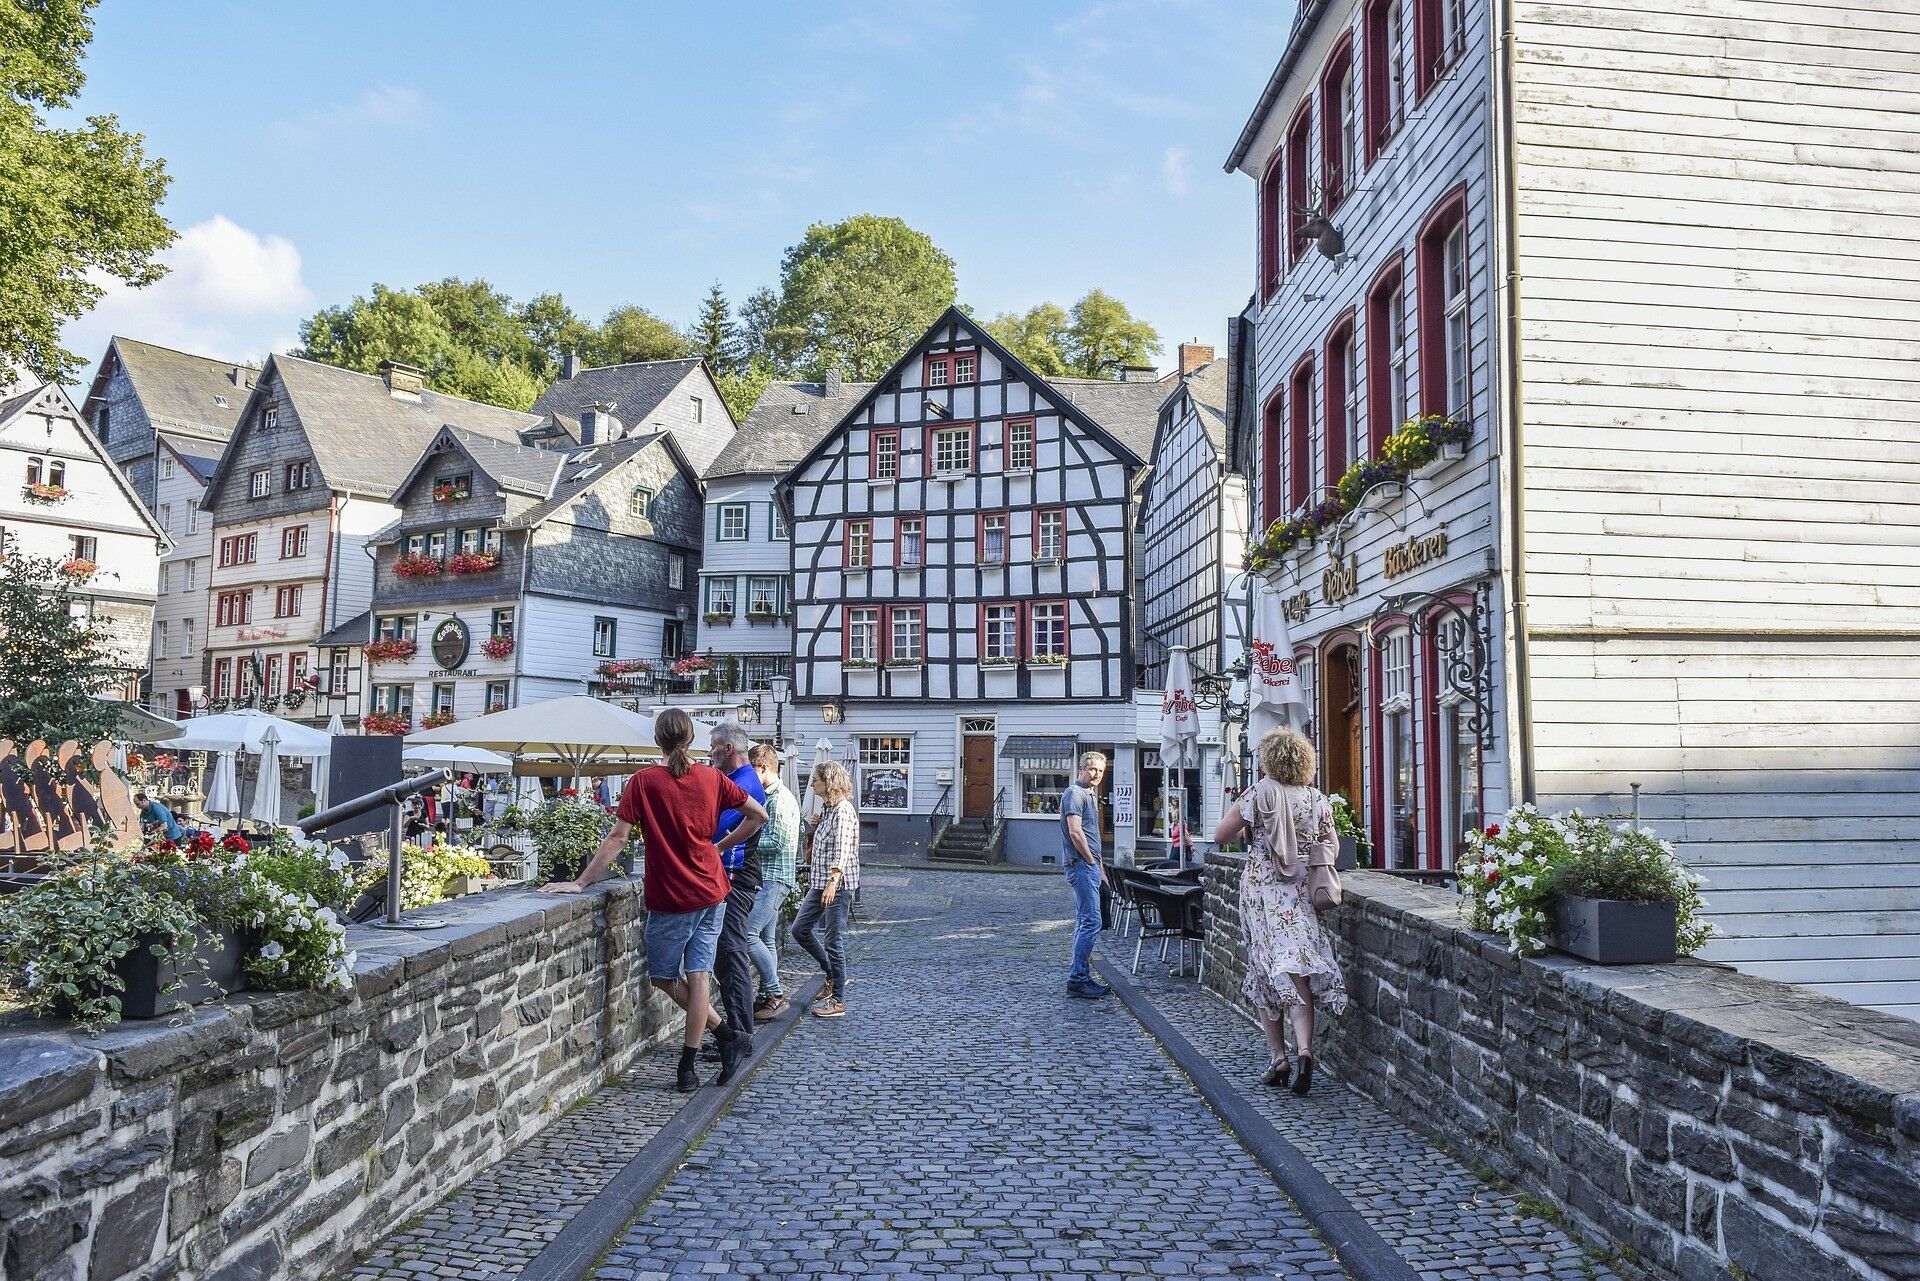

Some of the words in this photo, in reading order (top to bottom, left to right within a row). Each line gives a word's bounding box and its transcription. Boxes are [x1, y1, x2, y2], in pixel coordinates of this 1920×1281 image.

[1384, 522, 1448, 579] Bäckerei
[428, 669, 478, 678] RESTAURANT
[709, 709, 726, 718] Café
